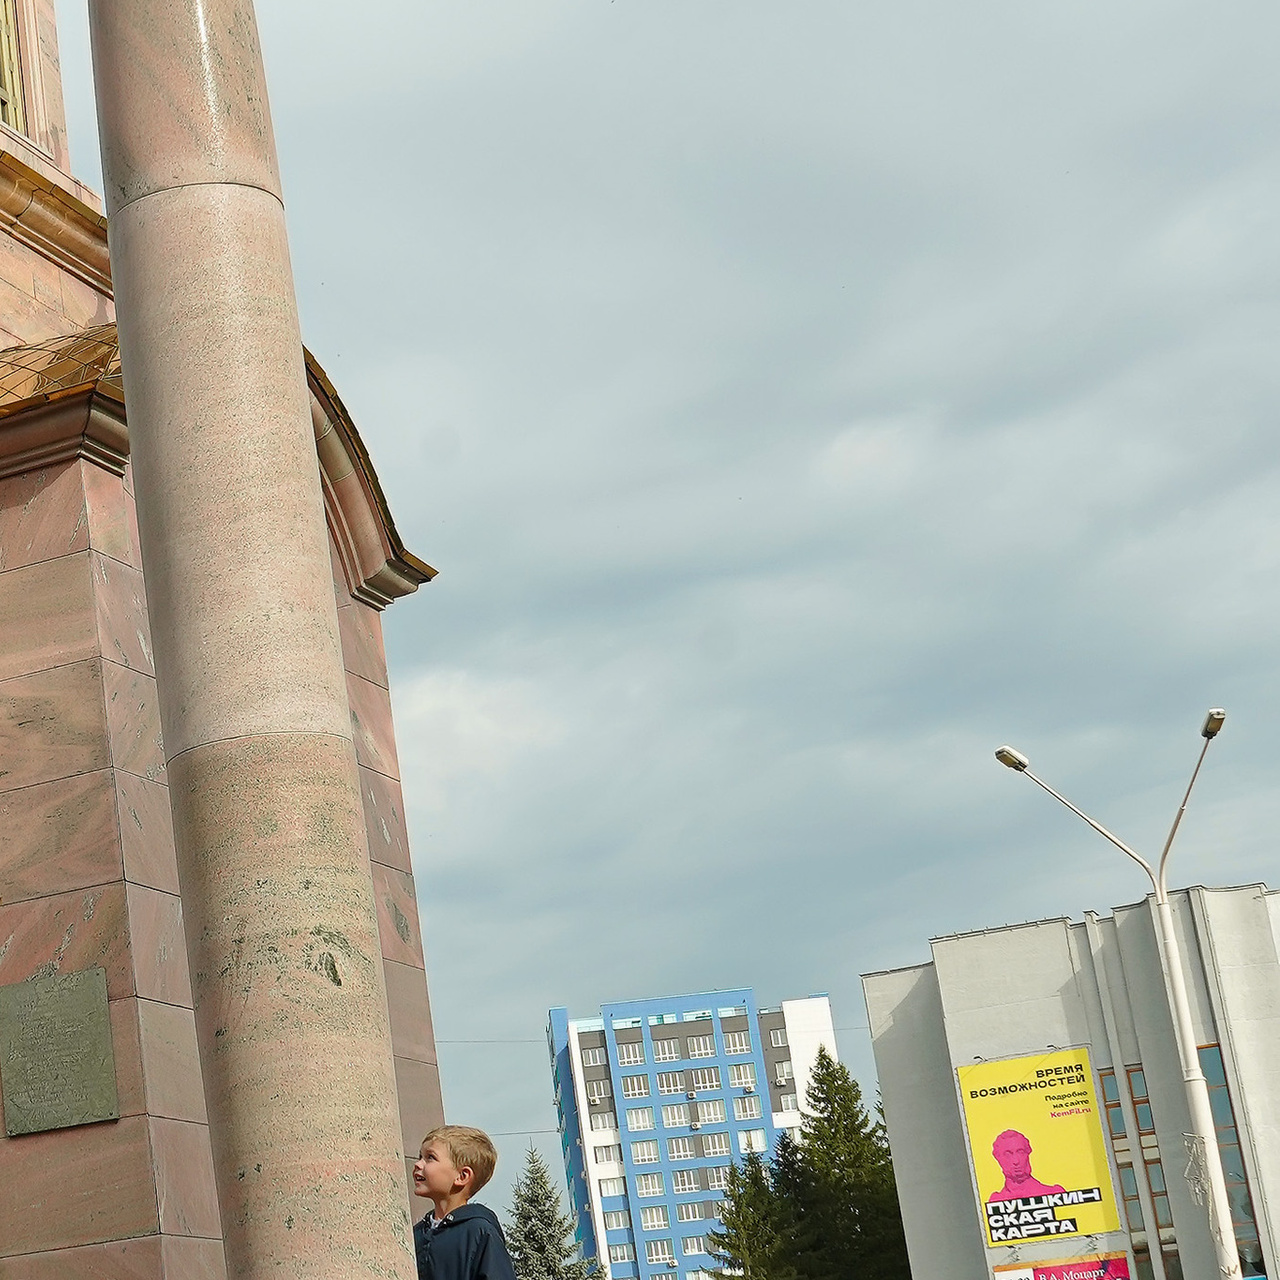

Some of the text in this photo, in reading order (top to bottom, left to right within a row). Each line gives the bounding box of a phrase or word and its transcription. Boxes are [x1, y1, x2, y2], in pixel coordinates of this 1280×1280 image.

[1036, 1064, 1084, 1078] ВРЕМЯ
[970, 1073, 1086, 1099] ВОЗМОЖНОСТЕЙ
[1045, 1091, 1088, 1101] Подробно
[1065, 1099, 1090, 1108] сайте
[986, 1189, 1100, 1215] ПУШКИН
[989, 1209, 1054, 1227] СКАЯ
[990, 1220, 1076, 1242] КАРТА
